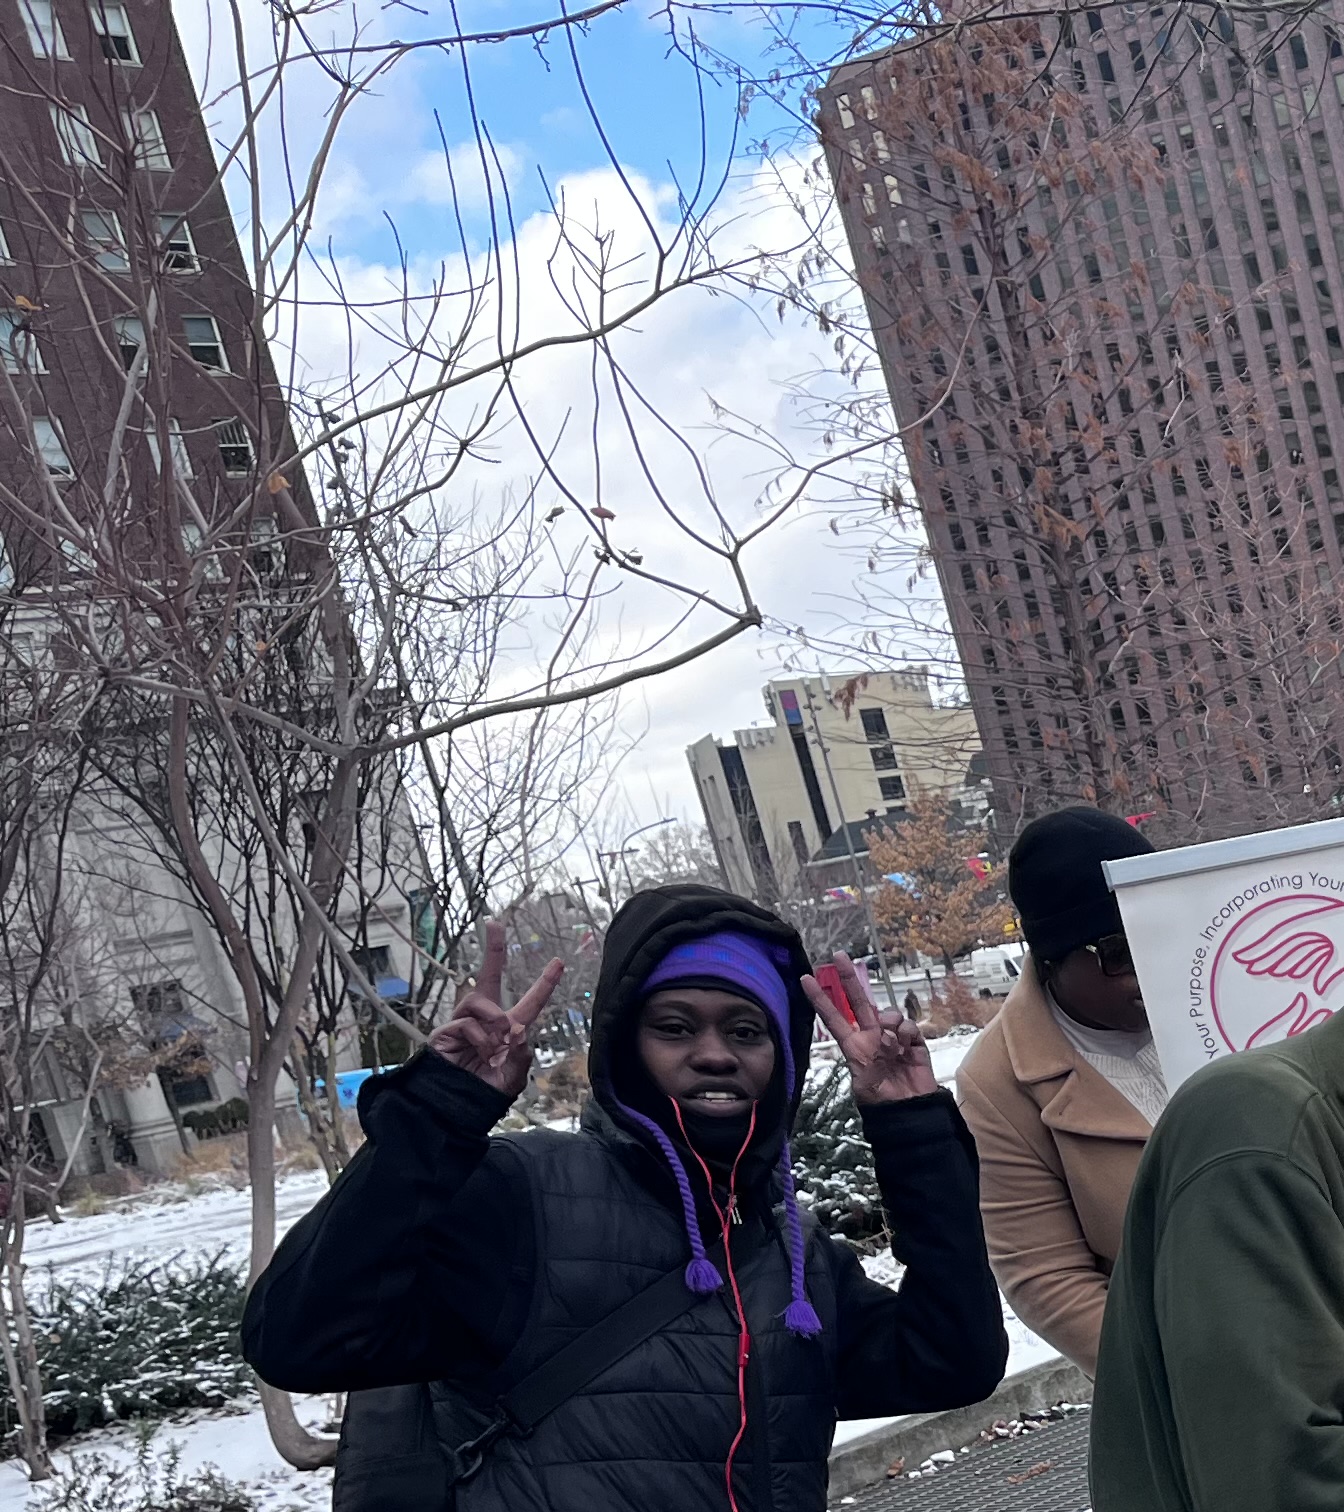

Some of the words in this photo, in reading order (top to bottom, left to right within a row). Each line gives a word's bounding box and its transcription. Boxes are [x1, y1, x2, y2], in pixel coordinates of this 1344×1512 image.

[1200, 874, 1303, 942] Incorporating
[1189, 945, 1210, 1018] Purpose,
[1195, 1021, 1220, 1060] Your
